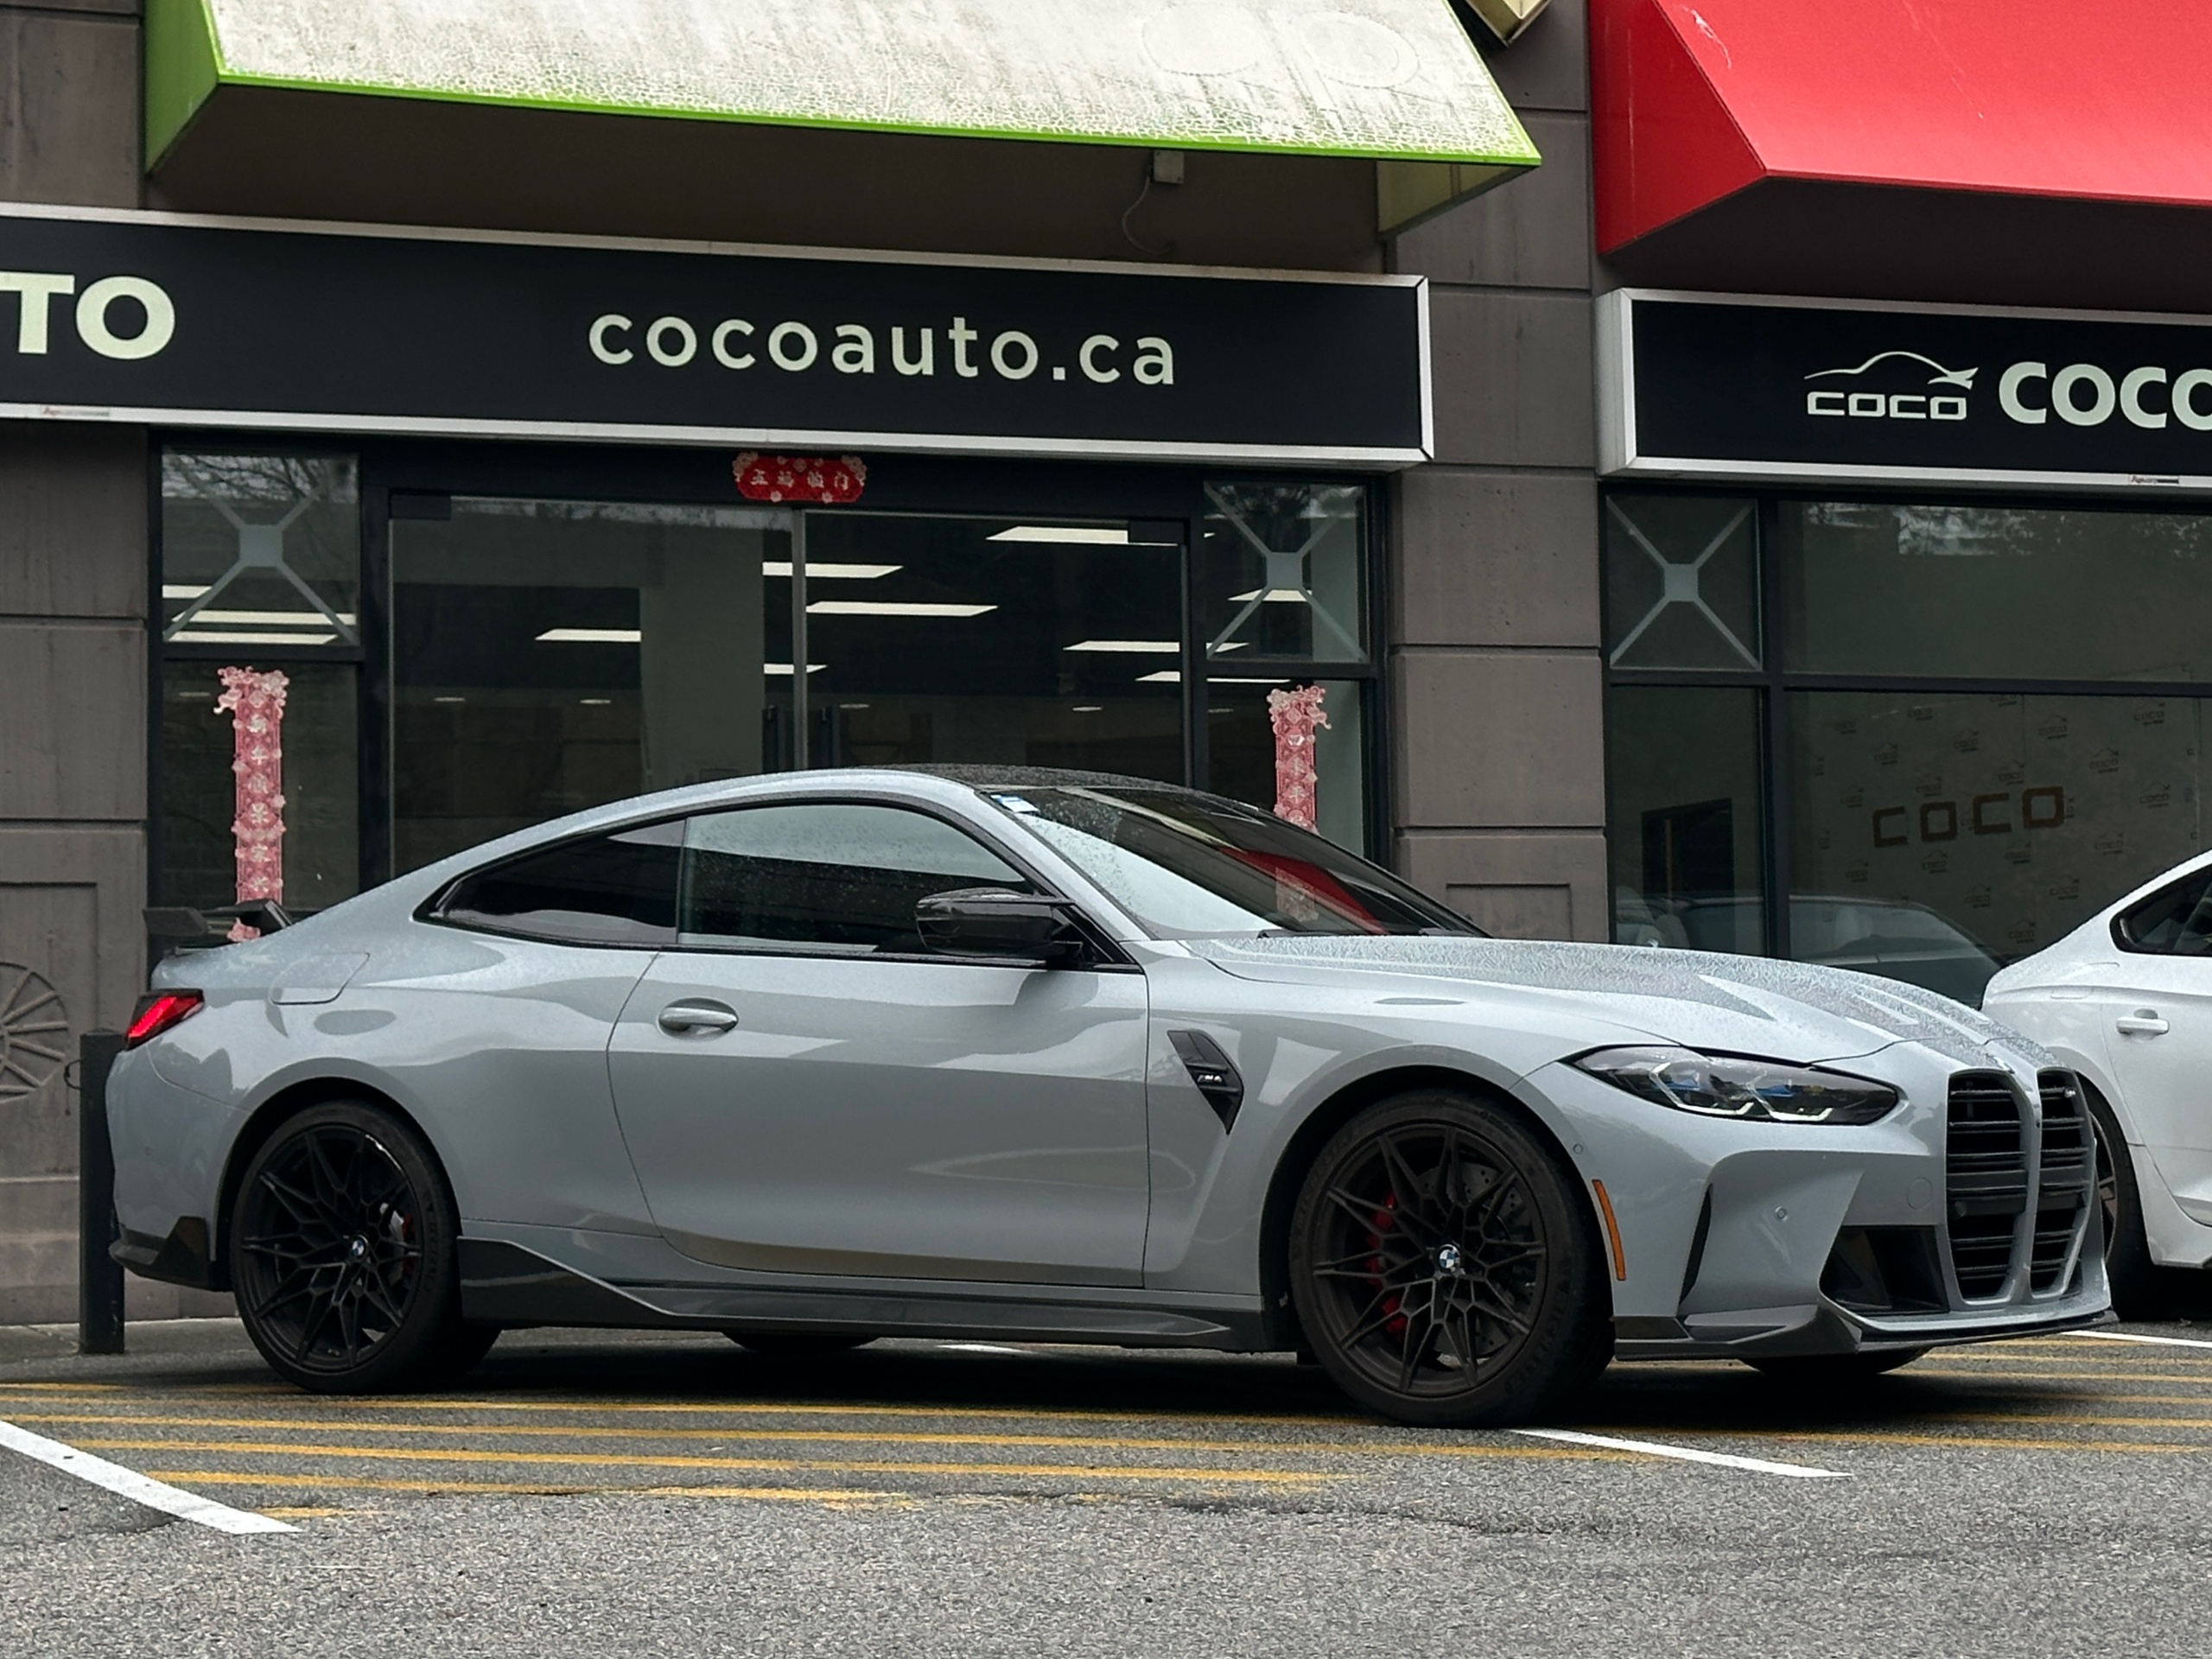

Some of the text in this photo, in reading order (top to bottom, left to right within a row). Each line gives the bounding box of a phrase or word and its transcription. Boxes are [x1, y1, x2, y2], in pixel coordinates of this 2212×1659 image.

[588, 315, 1173, 385] cocoauto.ca
[1807, 391, 1967, 421] COCO
[1999, 361, 2212, 431] COCO
[1872, 785, 2067, 849] COCO
